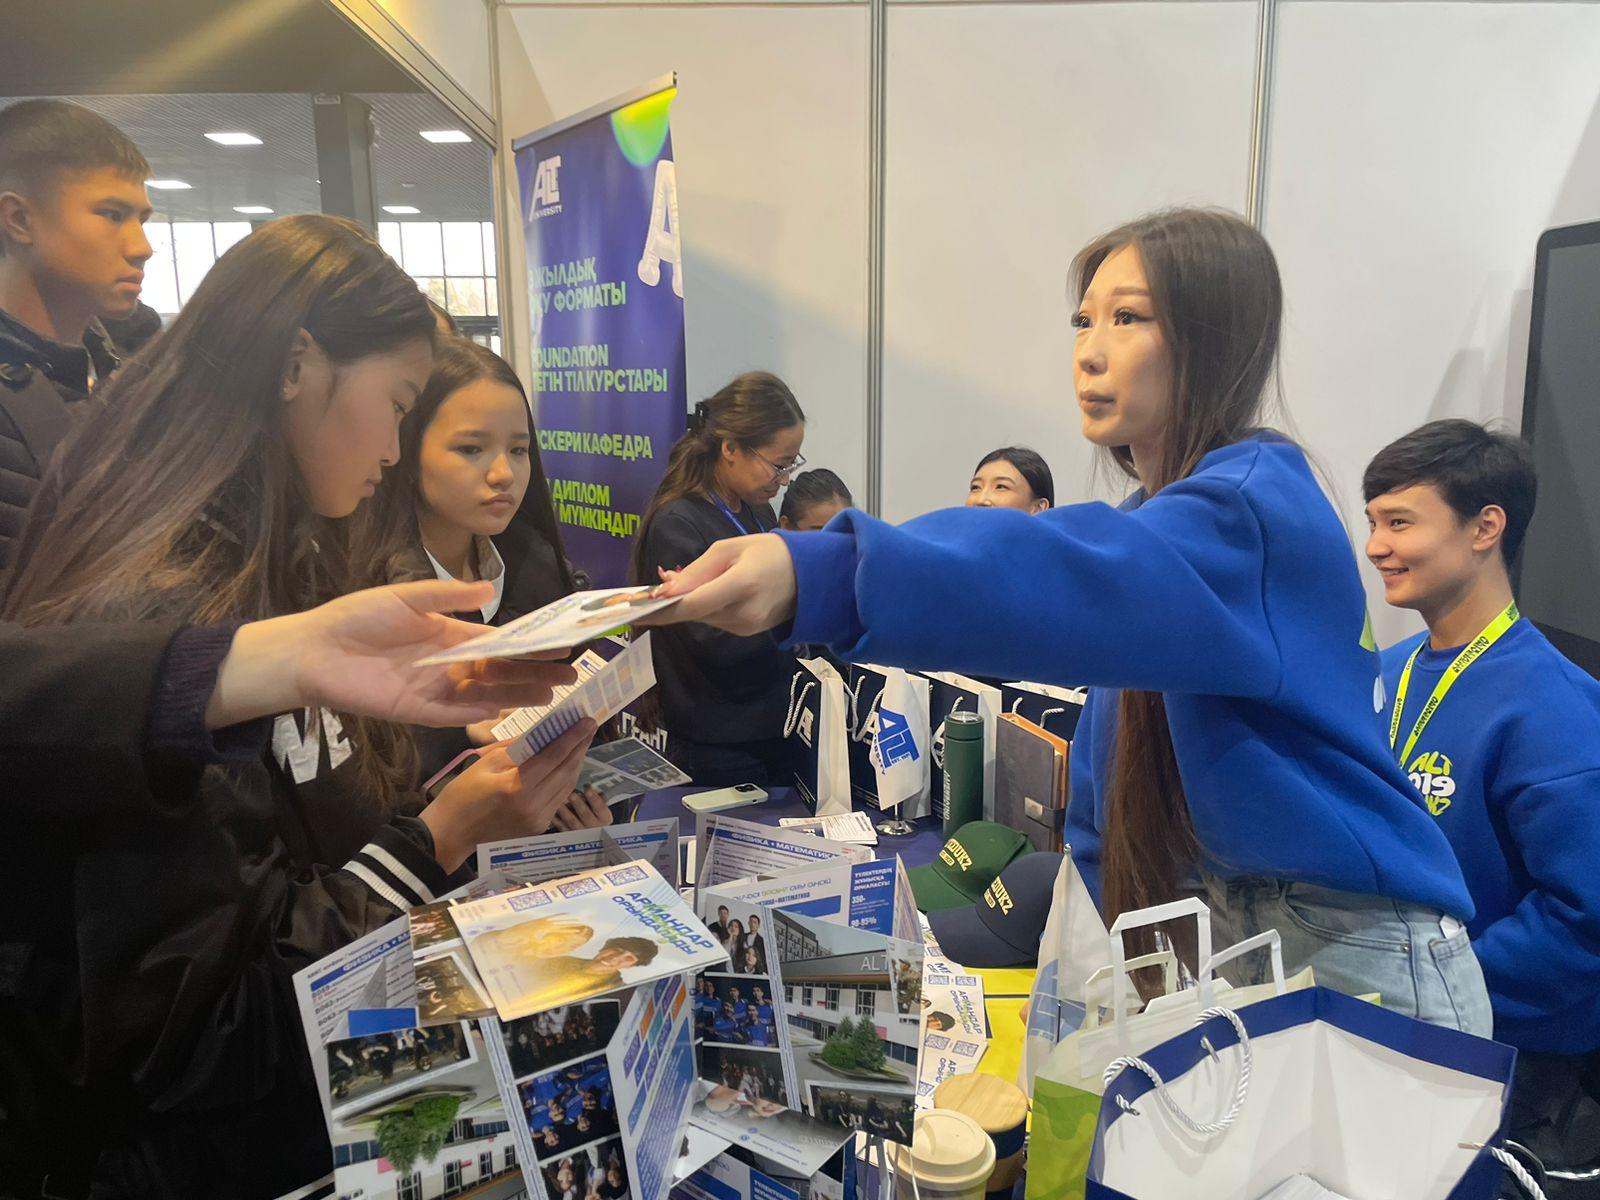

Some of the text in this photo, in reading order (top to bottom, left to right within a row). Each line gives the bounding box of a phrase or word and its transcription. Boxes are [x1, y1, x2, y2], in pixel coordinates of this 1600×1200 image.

[554, 281, 626, 313] ФОРМАТЫ
[586, 368, 668, 393] КУРСТАРЫ
[535, 429, 654, 462] СКЕРИ КАФЕДРА
[552, 478, 610, 508] ДИПЛОМ
[1408, 750, 1454, 776] ALT
[731, 832, 838, 860] ФИЗИКА МАТЕМАТИКА
[626, 892, 714, 949] АРМАНДАР
